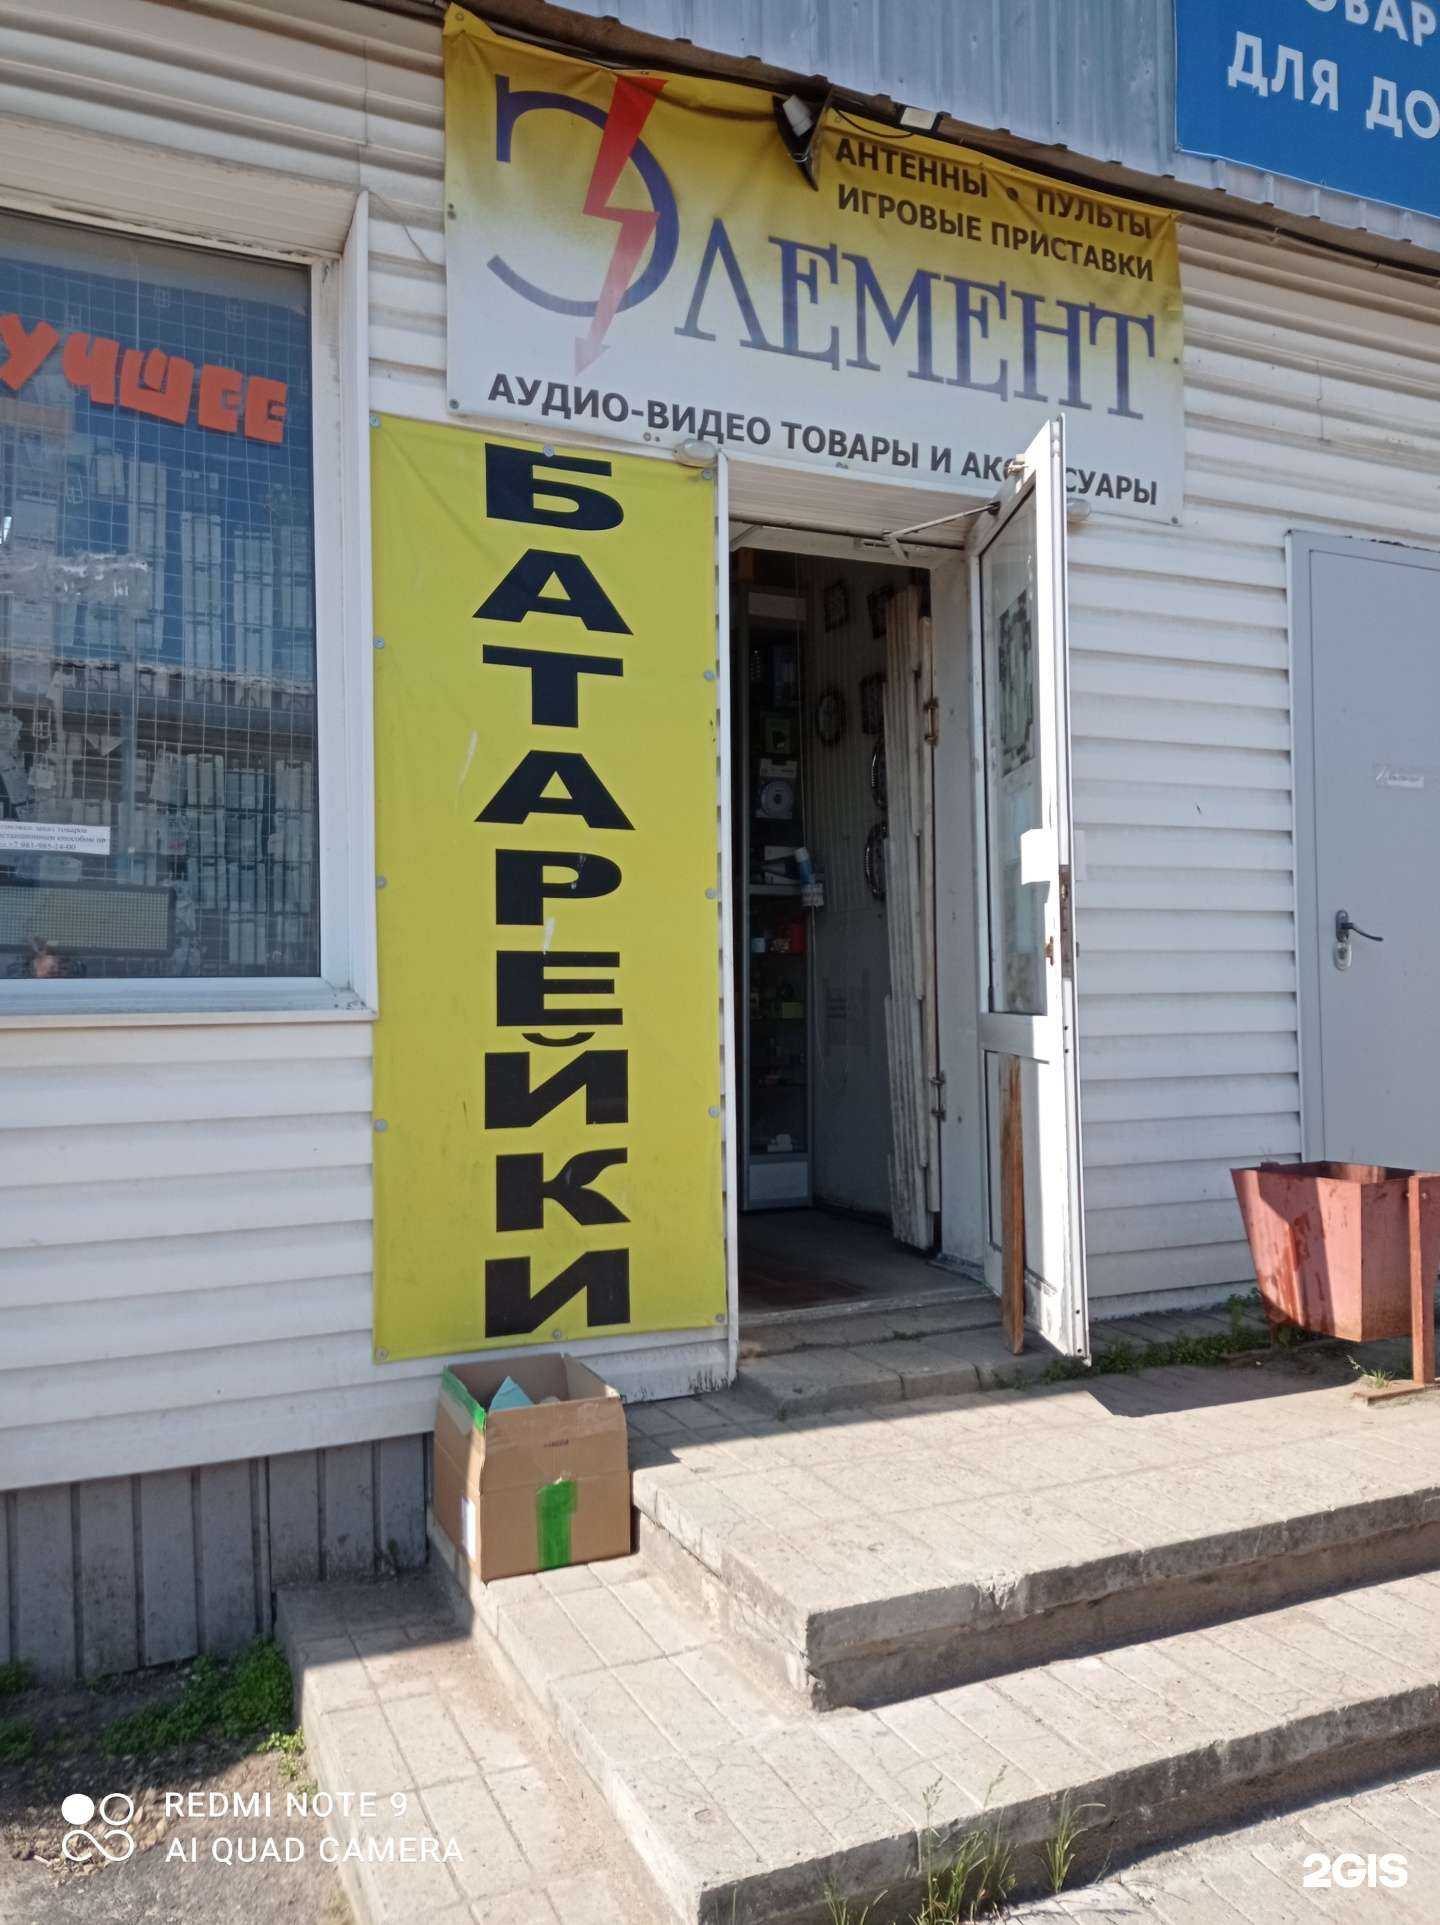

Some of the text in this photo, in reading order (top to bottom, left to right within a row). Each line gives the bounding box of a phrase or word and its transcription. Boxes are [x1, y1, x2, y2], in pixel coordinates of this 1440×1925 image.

[1307, 0, 1437, 47] ВАР
[1227, 31, 1440, 139] ДЛЯ ДО
[835, 137, 1153, 240] АНТЕННЫ ПУЛЬТЫ
[837, 183, 1154, 282] ИГРОВЫЕ ПРИСТАВКИ
[487, 373, 772, 445] АУДИО-ВИДЕО
[781, 421, 919, 469] ТОВАРЫ
[930, 445, 952, 474] И
[472, 442, 636, 1339] БАТАРЕЙКИ
